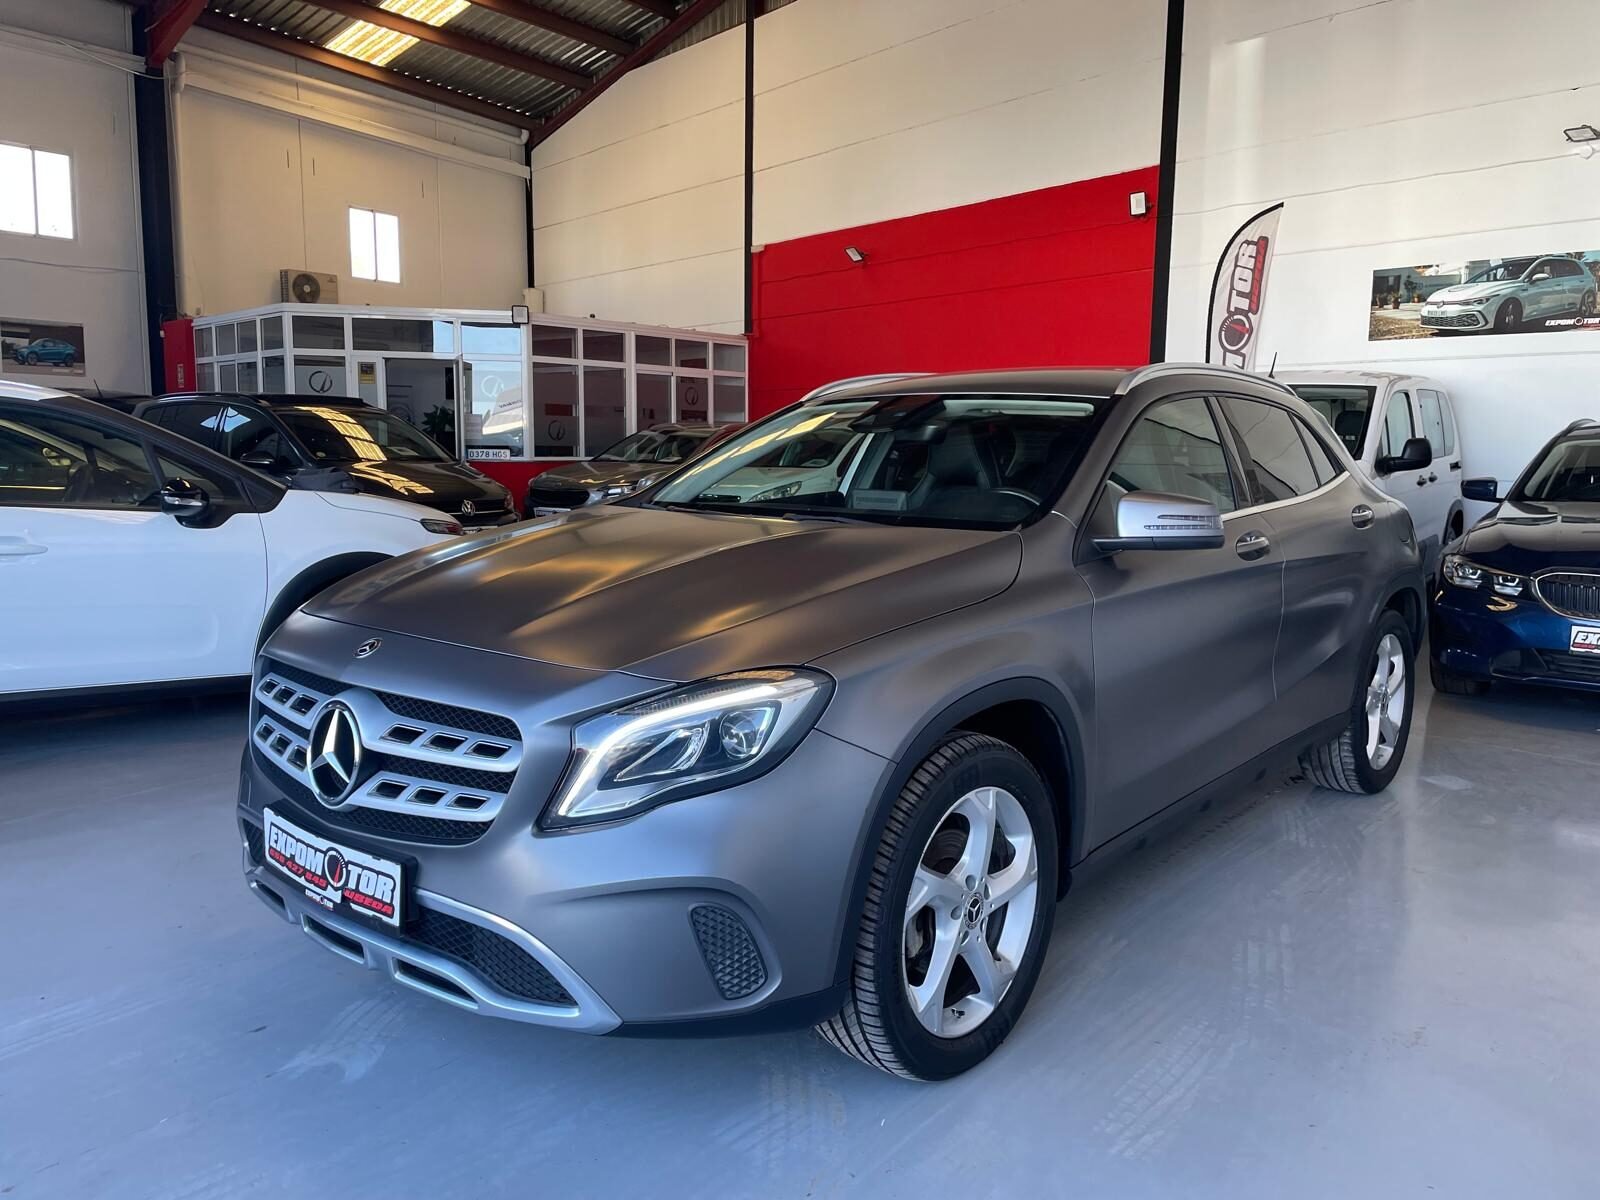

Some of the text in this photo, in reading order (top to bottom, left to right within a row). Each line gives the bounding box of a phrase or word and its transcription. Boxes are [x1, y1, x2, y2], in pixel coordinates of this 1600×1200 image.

[1545, 317, 1600, 326] EXPOMOTOR
[469, 450, 508, 459] 0378 HGS
[1573, 631, 1600, 645] EX
[269, 824, 395, 904] EXPOMOTOR
[285, 859, 305, 876] 427
[343, 887, 394, 916] UBEDA
